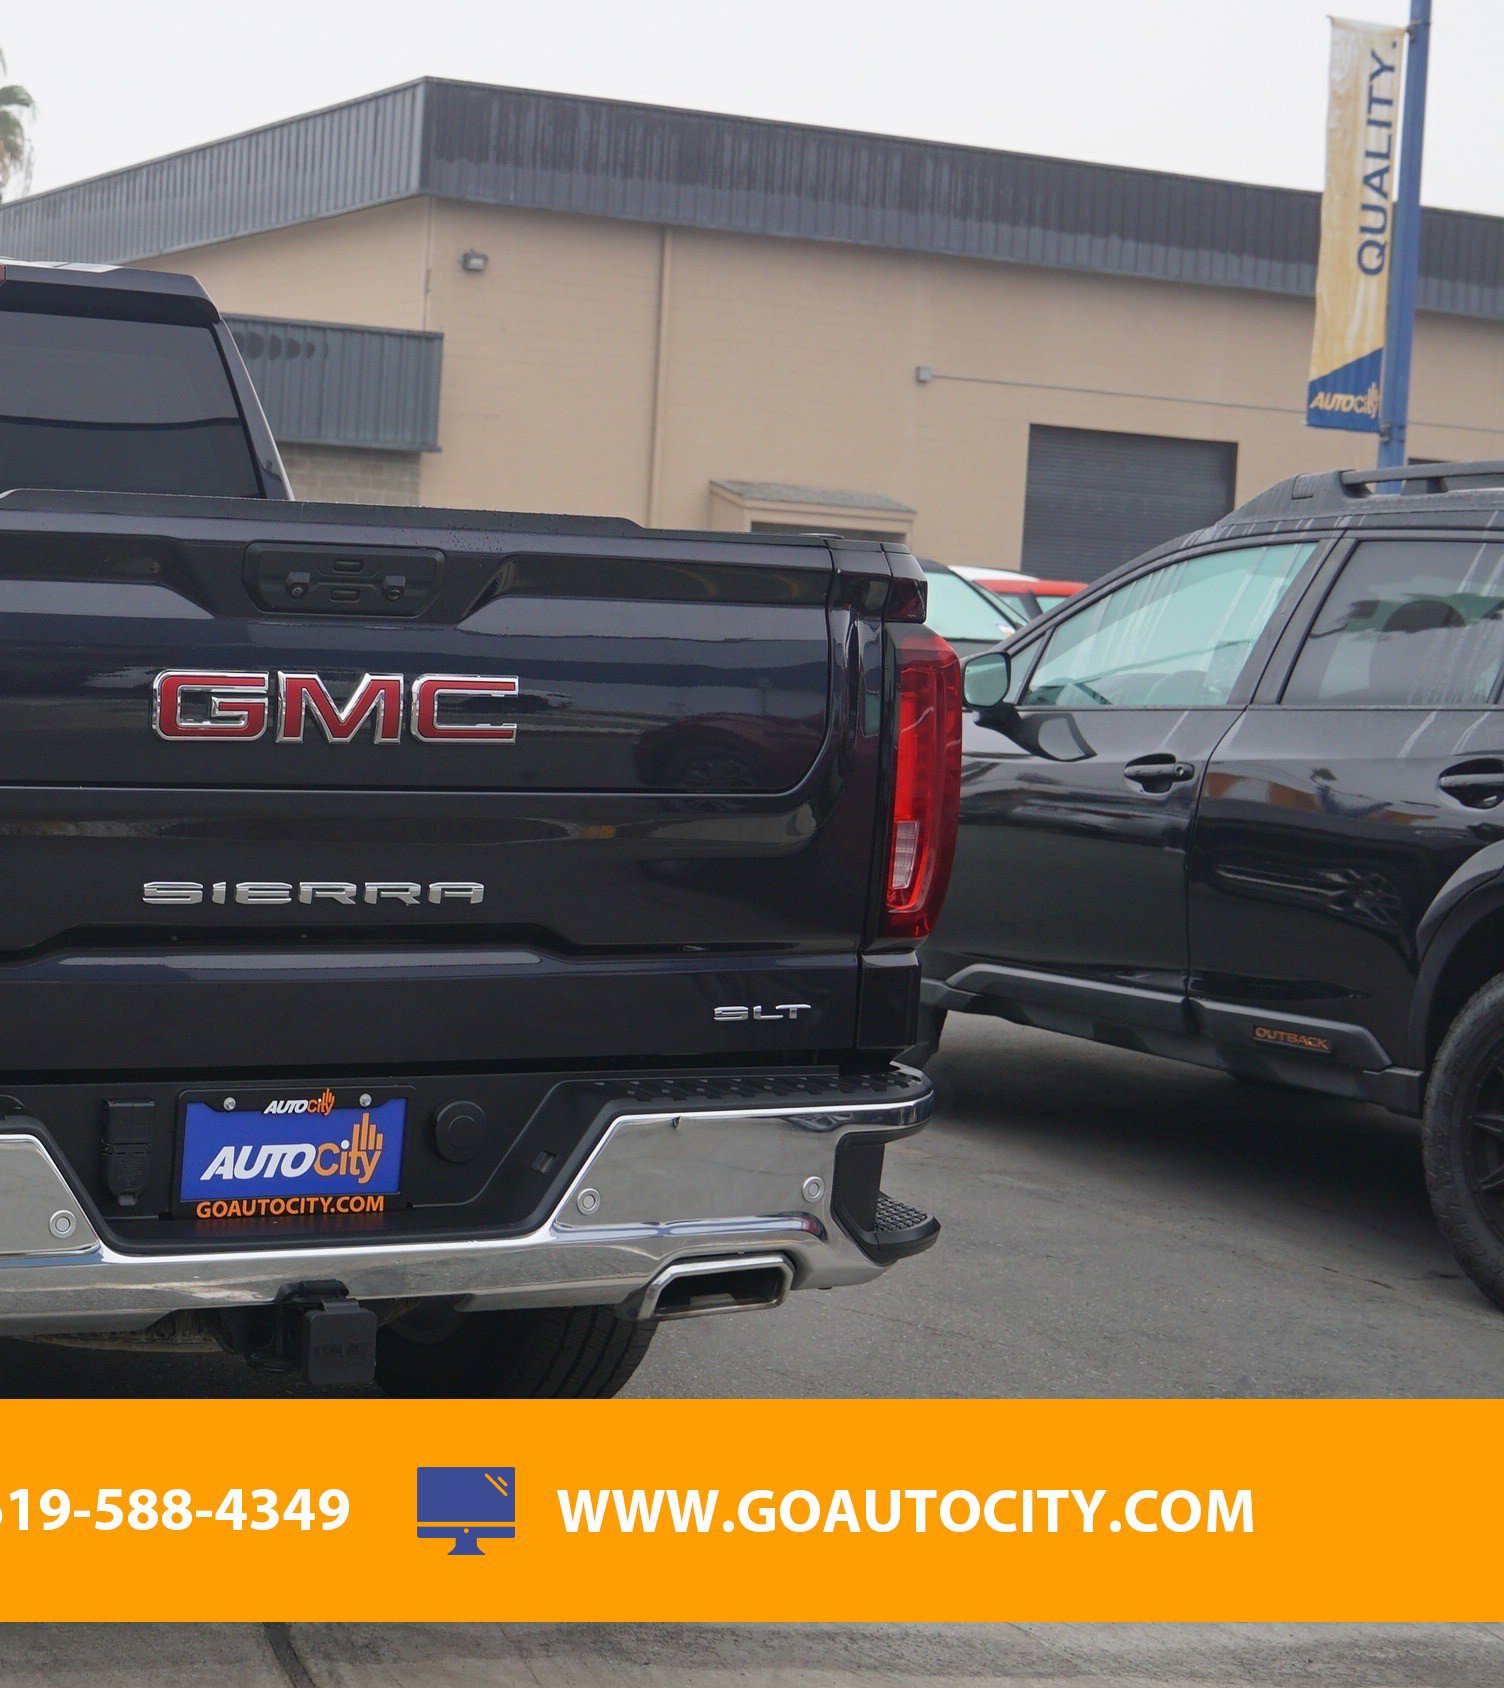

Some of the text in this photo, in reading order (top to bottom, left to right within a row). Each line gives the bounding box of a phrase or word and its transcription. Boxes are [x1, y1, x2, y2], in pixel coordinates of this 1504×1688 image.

[1357, 41, 1398, 275] QUALITY.
[152, 670, 519, 744] GMC
[142, 881, 485, 905] SIERRA
[714, 1004, 812, 1021] SLT
[1254, 1026, 1330, 1050] OUTBACK
[196, 1195, 385, 1219] GOAUTOCITY.COM
